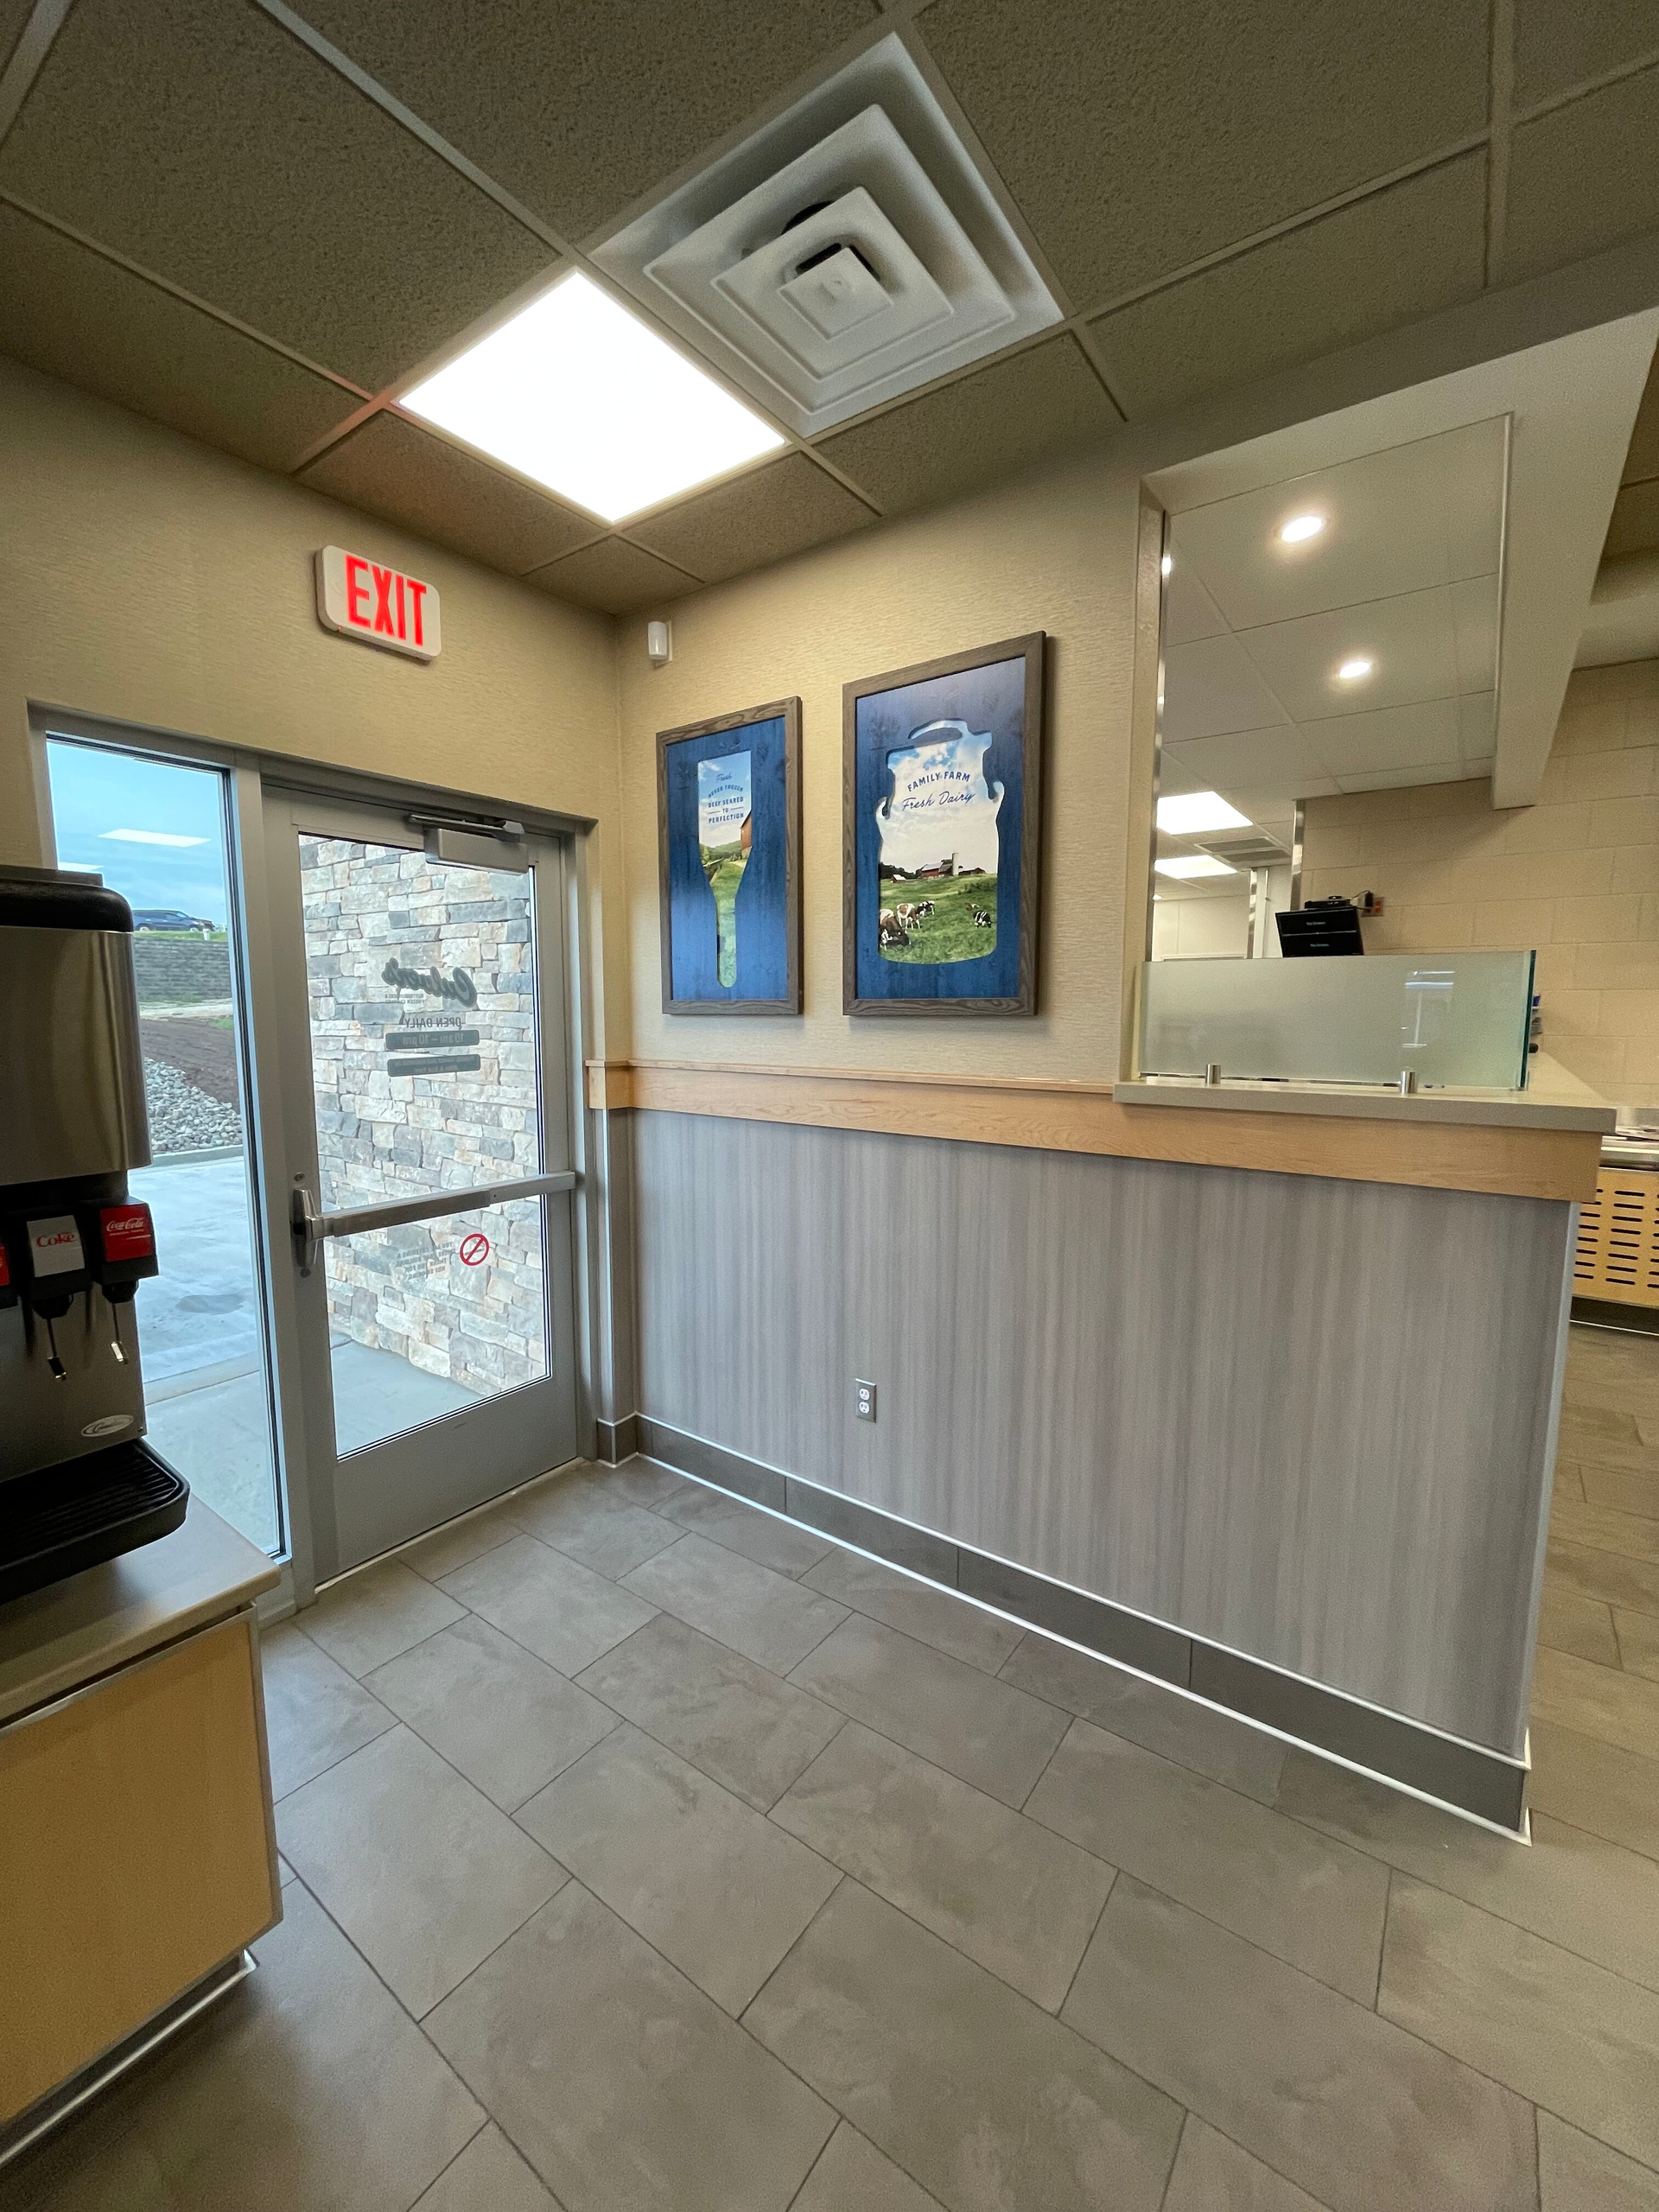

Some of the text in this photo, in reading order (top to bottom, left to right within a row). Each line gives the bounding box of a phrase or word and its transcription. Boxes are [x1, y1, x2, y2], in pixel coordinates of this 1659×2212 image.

[346, 554, 427, 646] EXIT
[907, 771, 971, 792] FAMILY FARM
[709, 786, 723, 798] NEVER
[722, 797, 743, 805] SEARED
[902, 791, 976, 811] Fresh Dairy
[709, 813, 744, 823] PERFECTION
[36, 1232, 76, 1247] Coke
